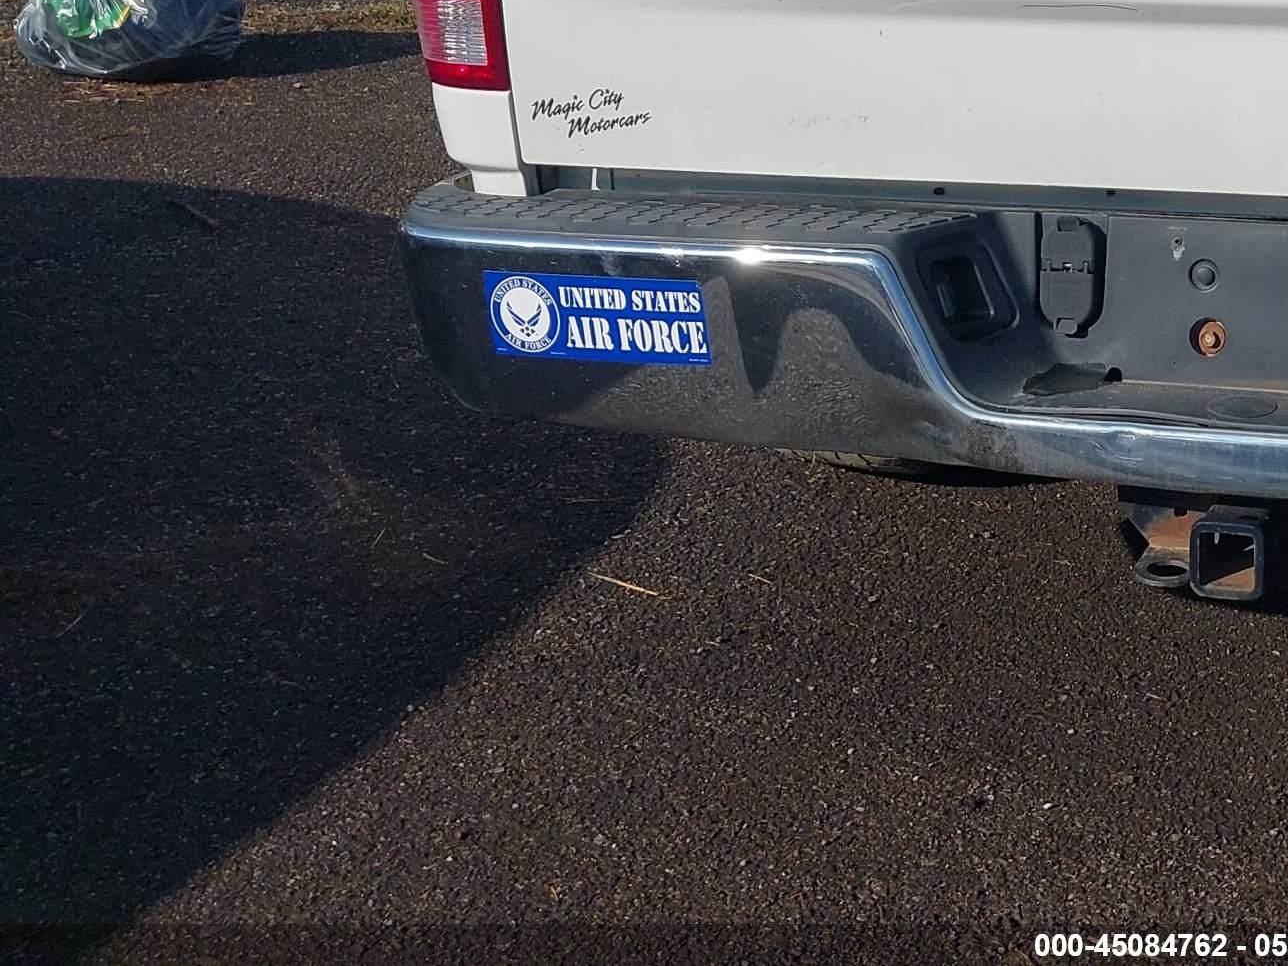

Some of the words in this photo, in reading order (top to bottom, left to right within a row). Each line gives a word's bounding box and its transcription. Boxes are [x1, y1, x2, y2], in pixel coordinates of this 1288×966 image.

[530, 95, 584, 121] Magic
[588, 88, 624, 111] City
[566, 112, 652, 138] Motorcars
[494, 279, 521, 303] UNITED
[522, 279, 553, 306] STATES
[558, 286, 627, 310] UNITED
[632, 289, 701, 314] STATES
[504, 333, 522, 347] AIR
[524, 335, 552, 350] FORCE
[566, 316, 614, 351] AIR
[617, 318, 708, 354] FORCE
